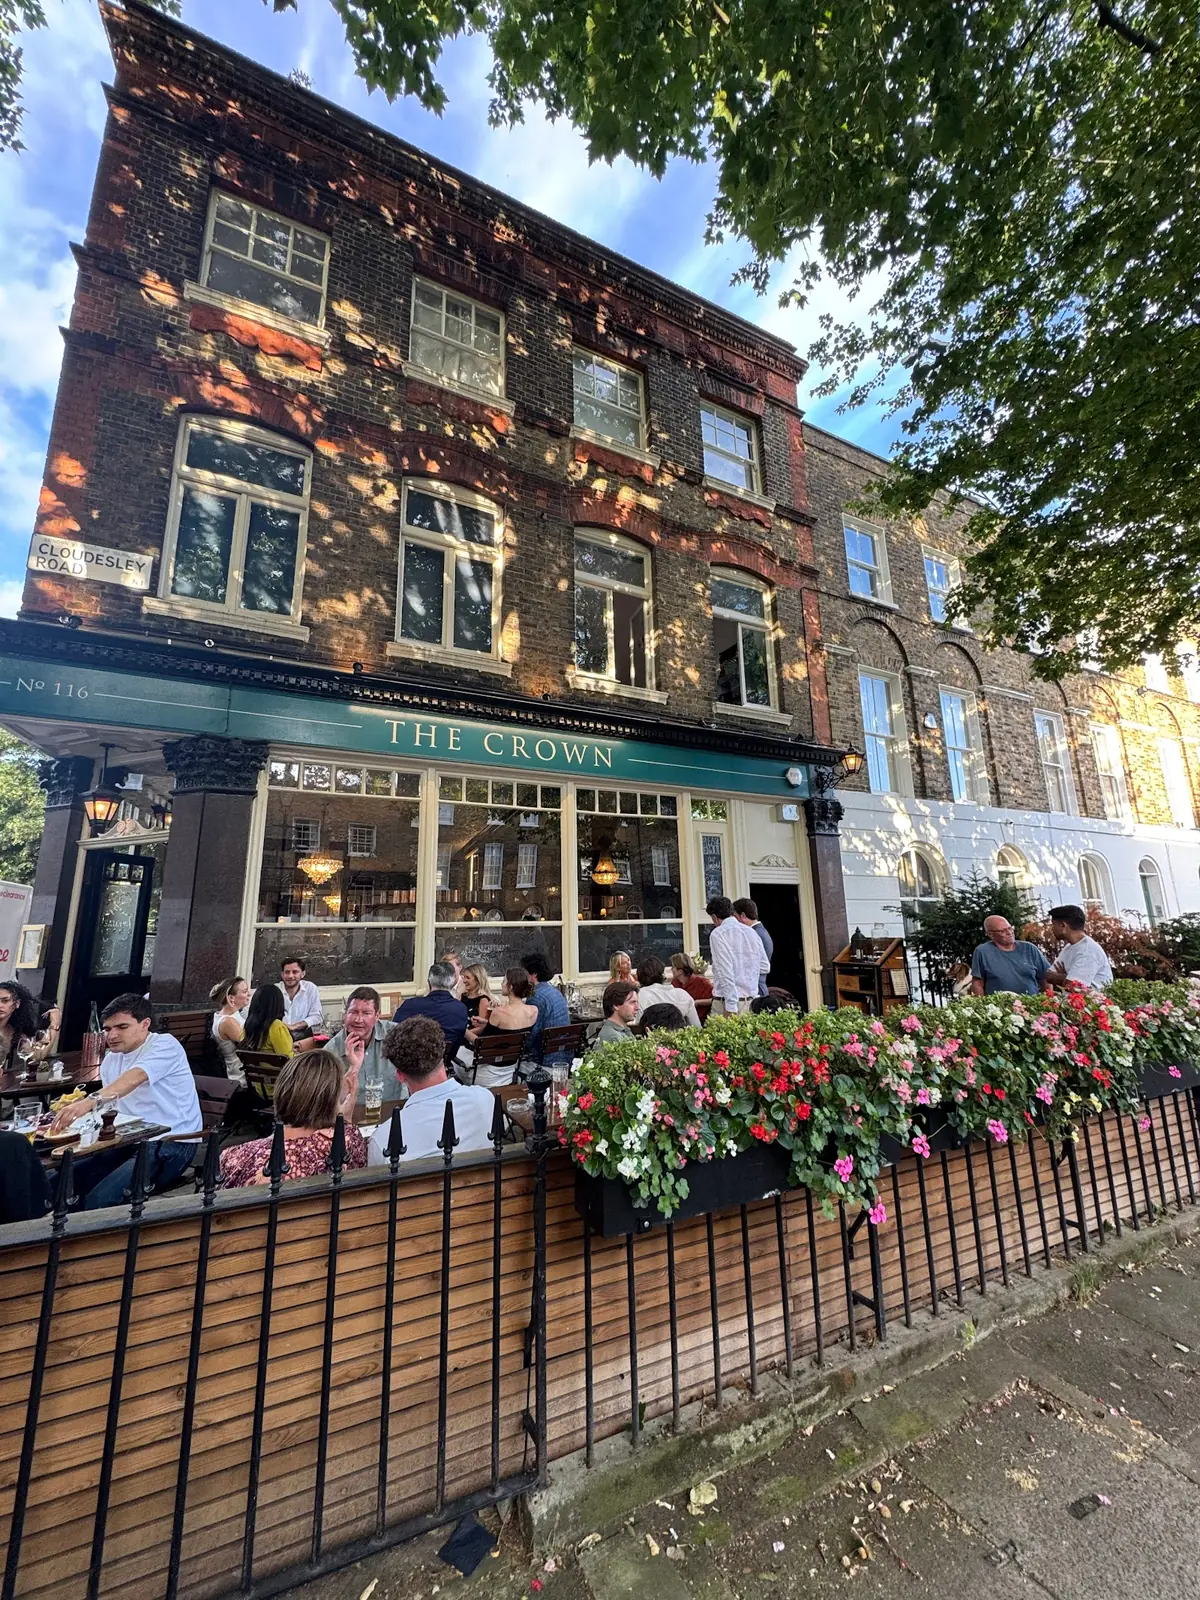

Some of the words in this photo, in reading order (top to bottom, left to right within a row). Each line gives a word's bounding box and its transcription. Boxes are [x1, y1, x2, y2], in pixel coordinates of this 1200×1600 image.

[35, 556, 83, 575] ROAD
[38, 543, 146, 573] CLOUDESLEY
[53, 682, 89, 699] 116
[384, 719, 461, 751] THE
[483, 732, 612, 769] CROWN
